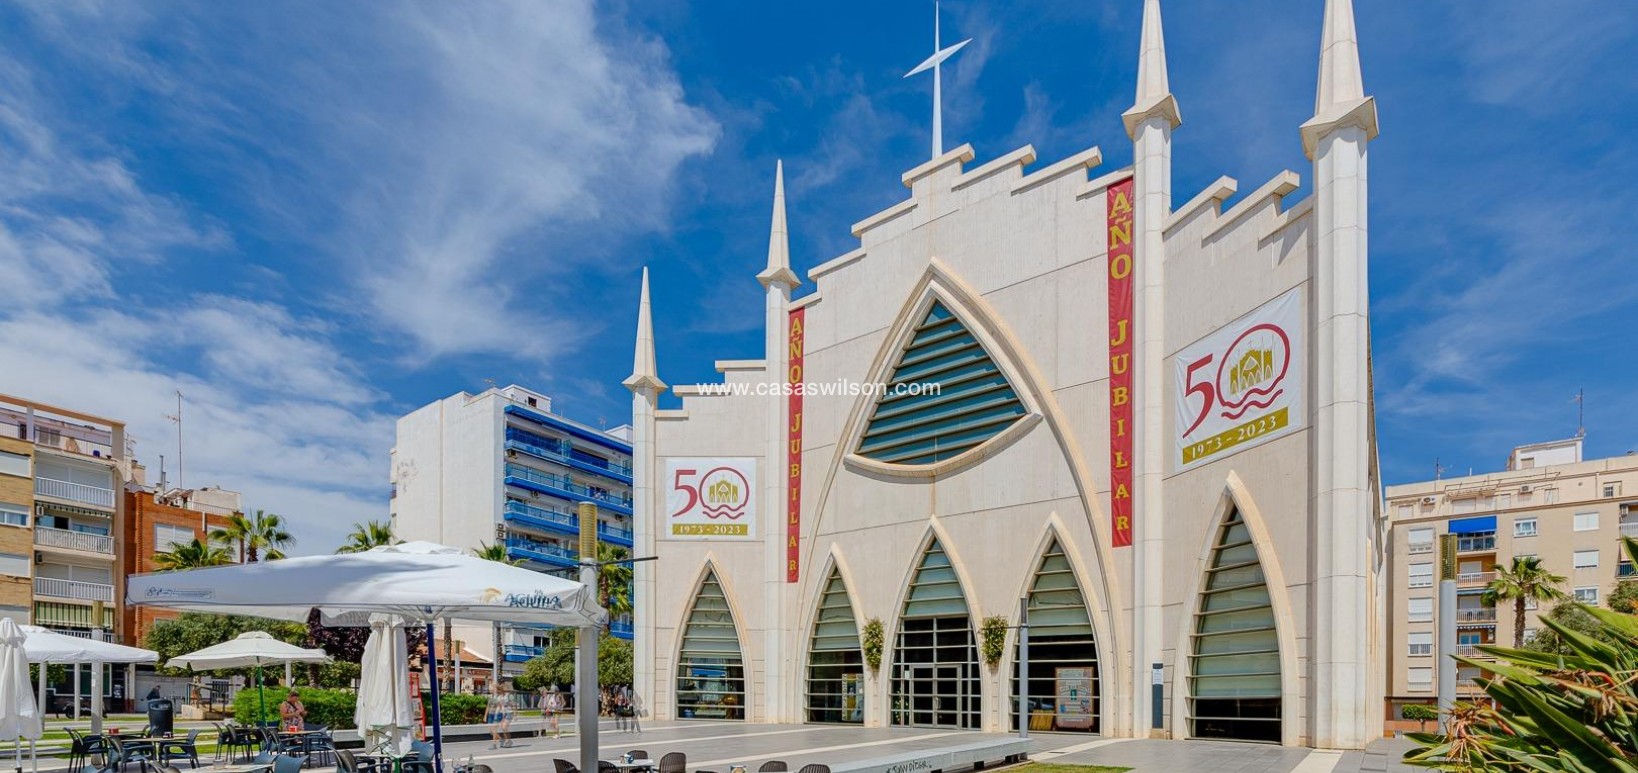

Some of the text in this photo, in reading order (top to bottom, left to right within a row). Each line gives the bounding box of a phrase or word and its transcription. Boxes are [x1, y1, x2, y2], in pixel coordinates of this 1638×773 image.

[1109, 191, 1133, 531] AÑO JUBILAR
[788, 317, 804, 573] AÑO JUBILAR
[1190, 437, 1223, 459] 1973
[1237, 415, 1277, 442] 2023
[679, 526, 703, 534] 1973
[713, 525, 741, 534] 2023
